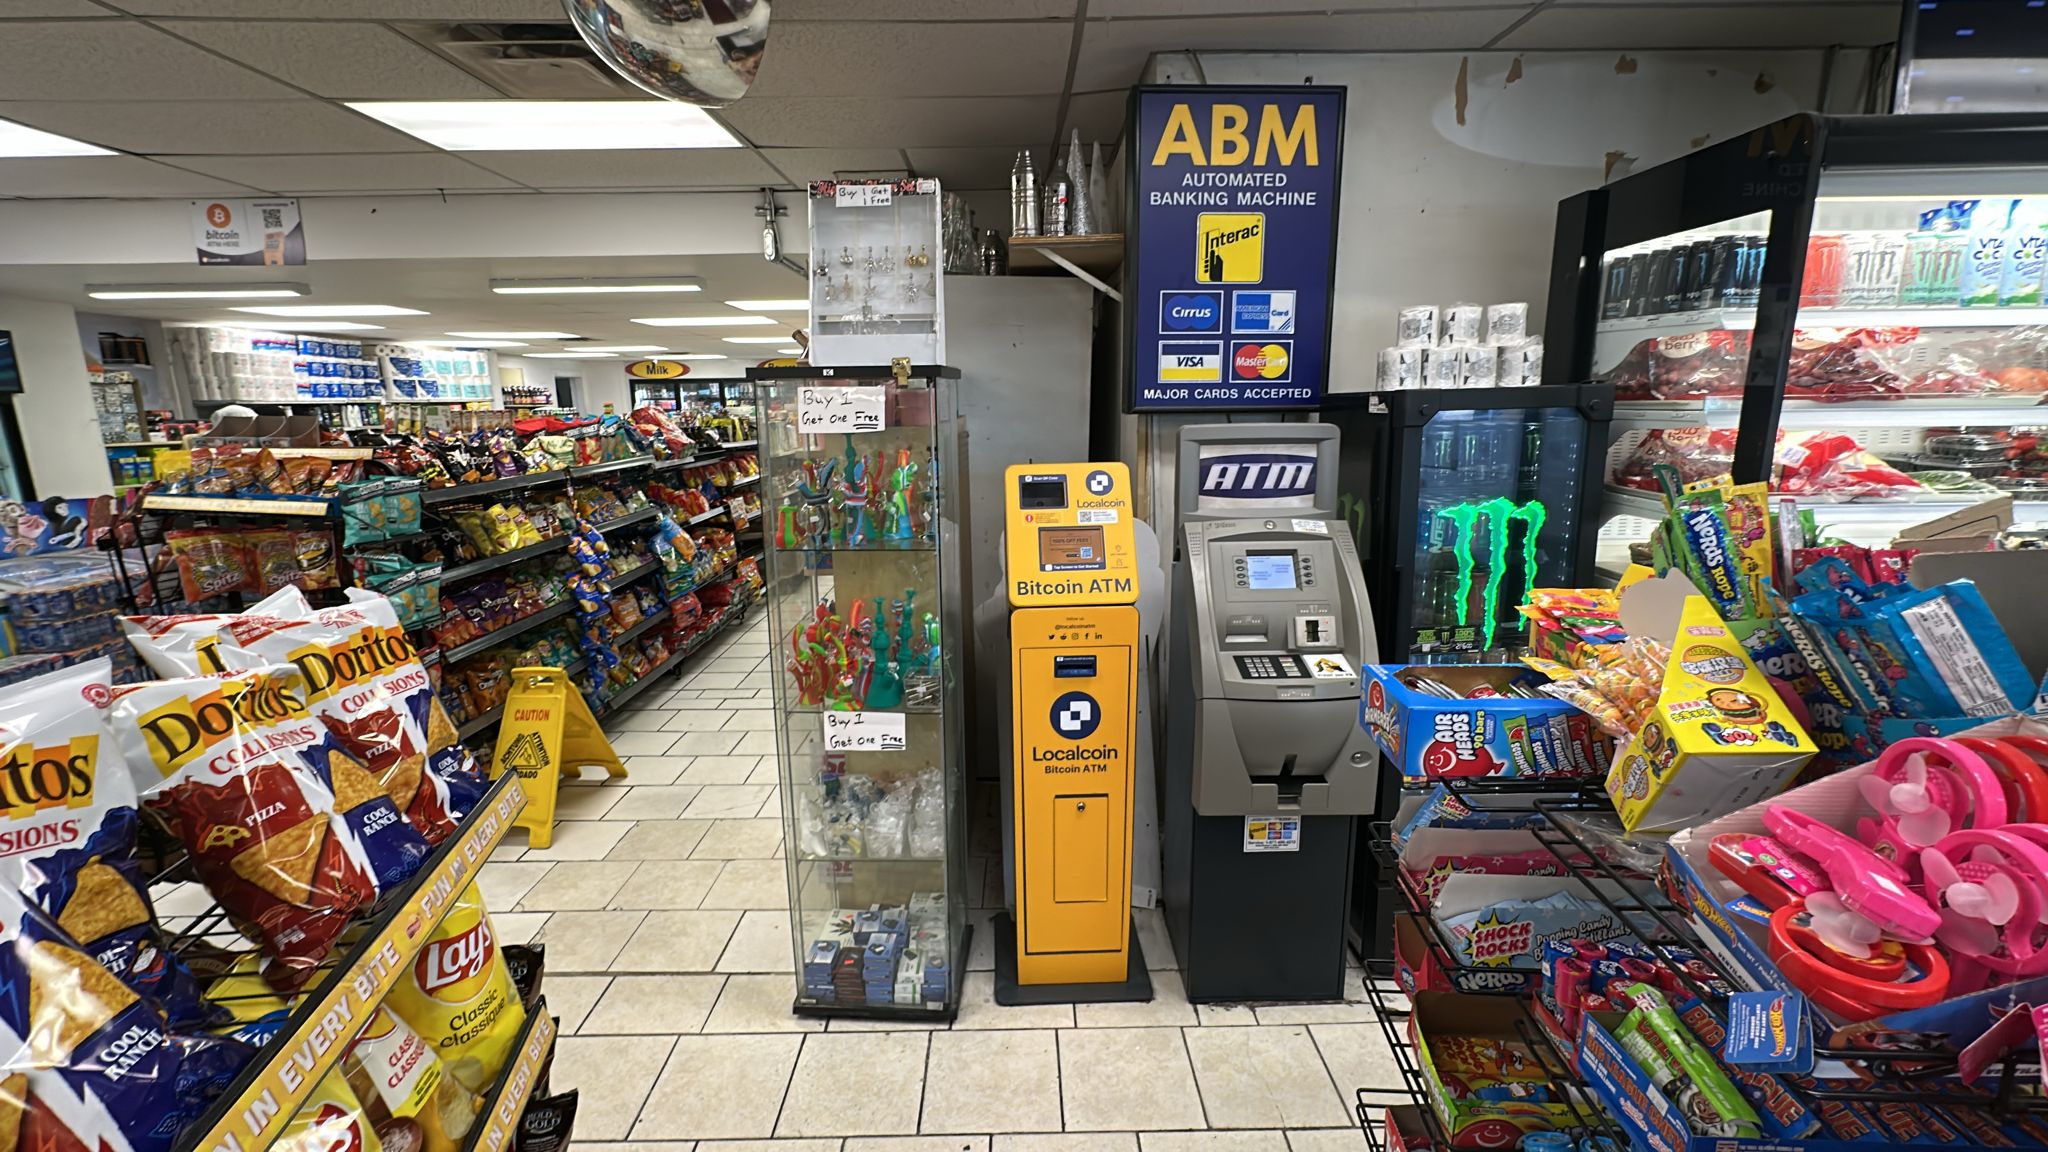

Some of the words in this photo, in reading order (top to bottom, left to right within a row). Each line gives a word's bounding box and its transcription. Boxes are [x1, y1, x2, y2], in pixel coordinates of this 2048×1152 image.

[1151, 103, 1319, 167] ABM
[1182, 172, 1288, 187] AUTOMATED
[839, 187, 857, 199] Buy
[871, 187, 888, 195] Get
[870, 197, 890, 205] Free
[1150, 191, 1229, 207] BANKING
[1237, 191, 1317, 206] MACHINE
[205, 230, 240, 240] bitcoin
[1171, 305, 1212, 319] Cirrus
[1271, 308, 1289, 318] Card
[646, 362, 669, 376] Milk
[1176, 356, 1204, 368] VISA
[802, 390, 834, 408] Buy
[841, 392, 853, 406] 1
[1143, 388, 1189, 400] MAJOR
[1194, 388, 1239, 400] CARDS
[1243, 388, 1312, 399] ACCEPTED
[801, 413, 824, 425] Get
[854, 411, 880, 423] Free
[1202, 463, 1315, 491] ATM
[1076, 498, 1126, 508] Localcoin
[202, 571, 241, 594] Spitz
[268, 570, 304, 587] Spitz
[1016, 579, 1083, 596] Bitcoin
[1088, 578, 1132, 594] ATM
[289, 629, 418, 697] Doritos
[140, 680, 304, 765] Doritos
[514, 708, 551, 722] CAUTION
[827, 714, 851, 728] Buy
[853, 713, 865, 725] 1
[1474, 710, 1485, 734] bars
[1434, 713, 1455, 743] AIR
[1452, 713, 1477, 761] HEADS
[529, 731, 551, 768] ATTENTION
[829, 735, 853, 749] Get
[880, 734, 904, 744] Free
[1473, 734, 1485, 749] 90
[1032, 745, 1118, 762] Localcoin
[1510, 741, 1535, 776] AIRHEADS
[1531, 740, 1556, 775] AIRHEADS
[1044, 764, 1081, 774] Bitcoin
[1082, 763, 1107, 773] ATM
[244, 800, 288, 828] PIZZA
[362, 804, 393, 824] COOL
[362, 811, 399, 837] RANCH
[421, 875, 453, 921] FUN
[463, 812, 501, 866] EVERY
[497, 785, 522, 822] BITE
[1474, 921, 1533, 945] SHOCK
[1579, 914, 1613, 933] Candy
[425, 916, 494, 992] Lay's
[1473, 937, 1531, 961] ROCKS
[449, 988, 499, 1033] Classic
[439, 998, 506, 1049] Classique
[1682, 1004, 1727, 1048] BIG
[99, 1024, 149, 1064] COOL
[242, 1087, 281, 1138] IN
[278, 995, 356, 1095] EVERY
[353, 940, 402, 1003] BITE
[102, 1027, 164, 1083] RANCH
[486, 1126, 504, 1150] IN
[499, 1060, 532, 1127] EVERY
[527, 1018, 551, 1063] BITE
[525, 1116, 562, 1130] GOLD
